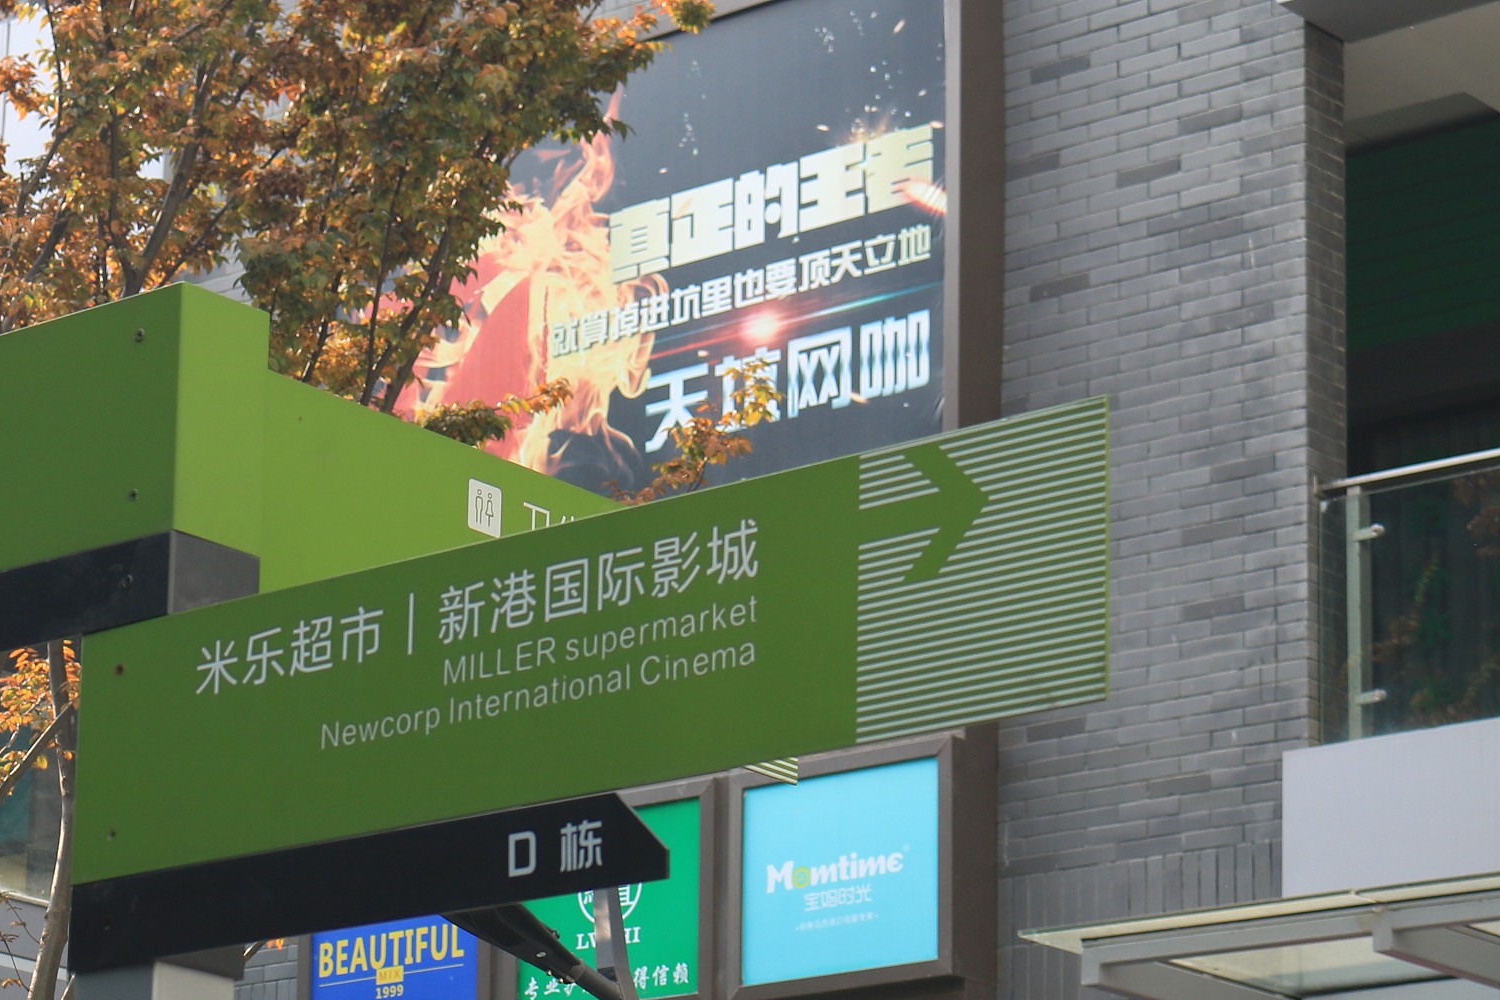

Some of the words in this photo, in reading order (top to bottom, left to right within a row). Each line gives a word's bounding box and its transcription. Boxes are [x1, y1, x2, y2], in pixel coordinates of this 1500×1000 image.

[610, 123, 934, 284] 真正的王者
[552, 224, 932, 359] 就算掉进坑里也要顶天立地
[194, 603, 384, 698] 米乐超市
[438, 517, 760, 646] 新港国际影城
[442, 634, 558, 687] MILLER
[565, 594, 758, 663] supermarket
[320, 702, 442, 750] Newcorp
[449, 662, 632, 726] International
[639, 640, 756, 688] Cinema
[508, 830, 537, 878] D
[560, 819, 603, 873] 栋
[766, 851, 904, 894] Momtime
[804, 883, 873, 912] 宝妈时光
[319, 924, 464, 978] BEAUTIFUL
[375, 984, 404, 1000] 1999
